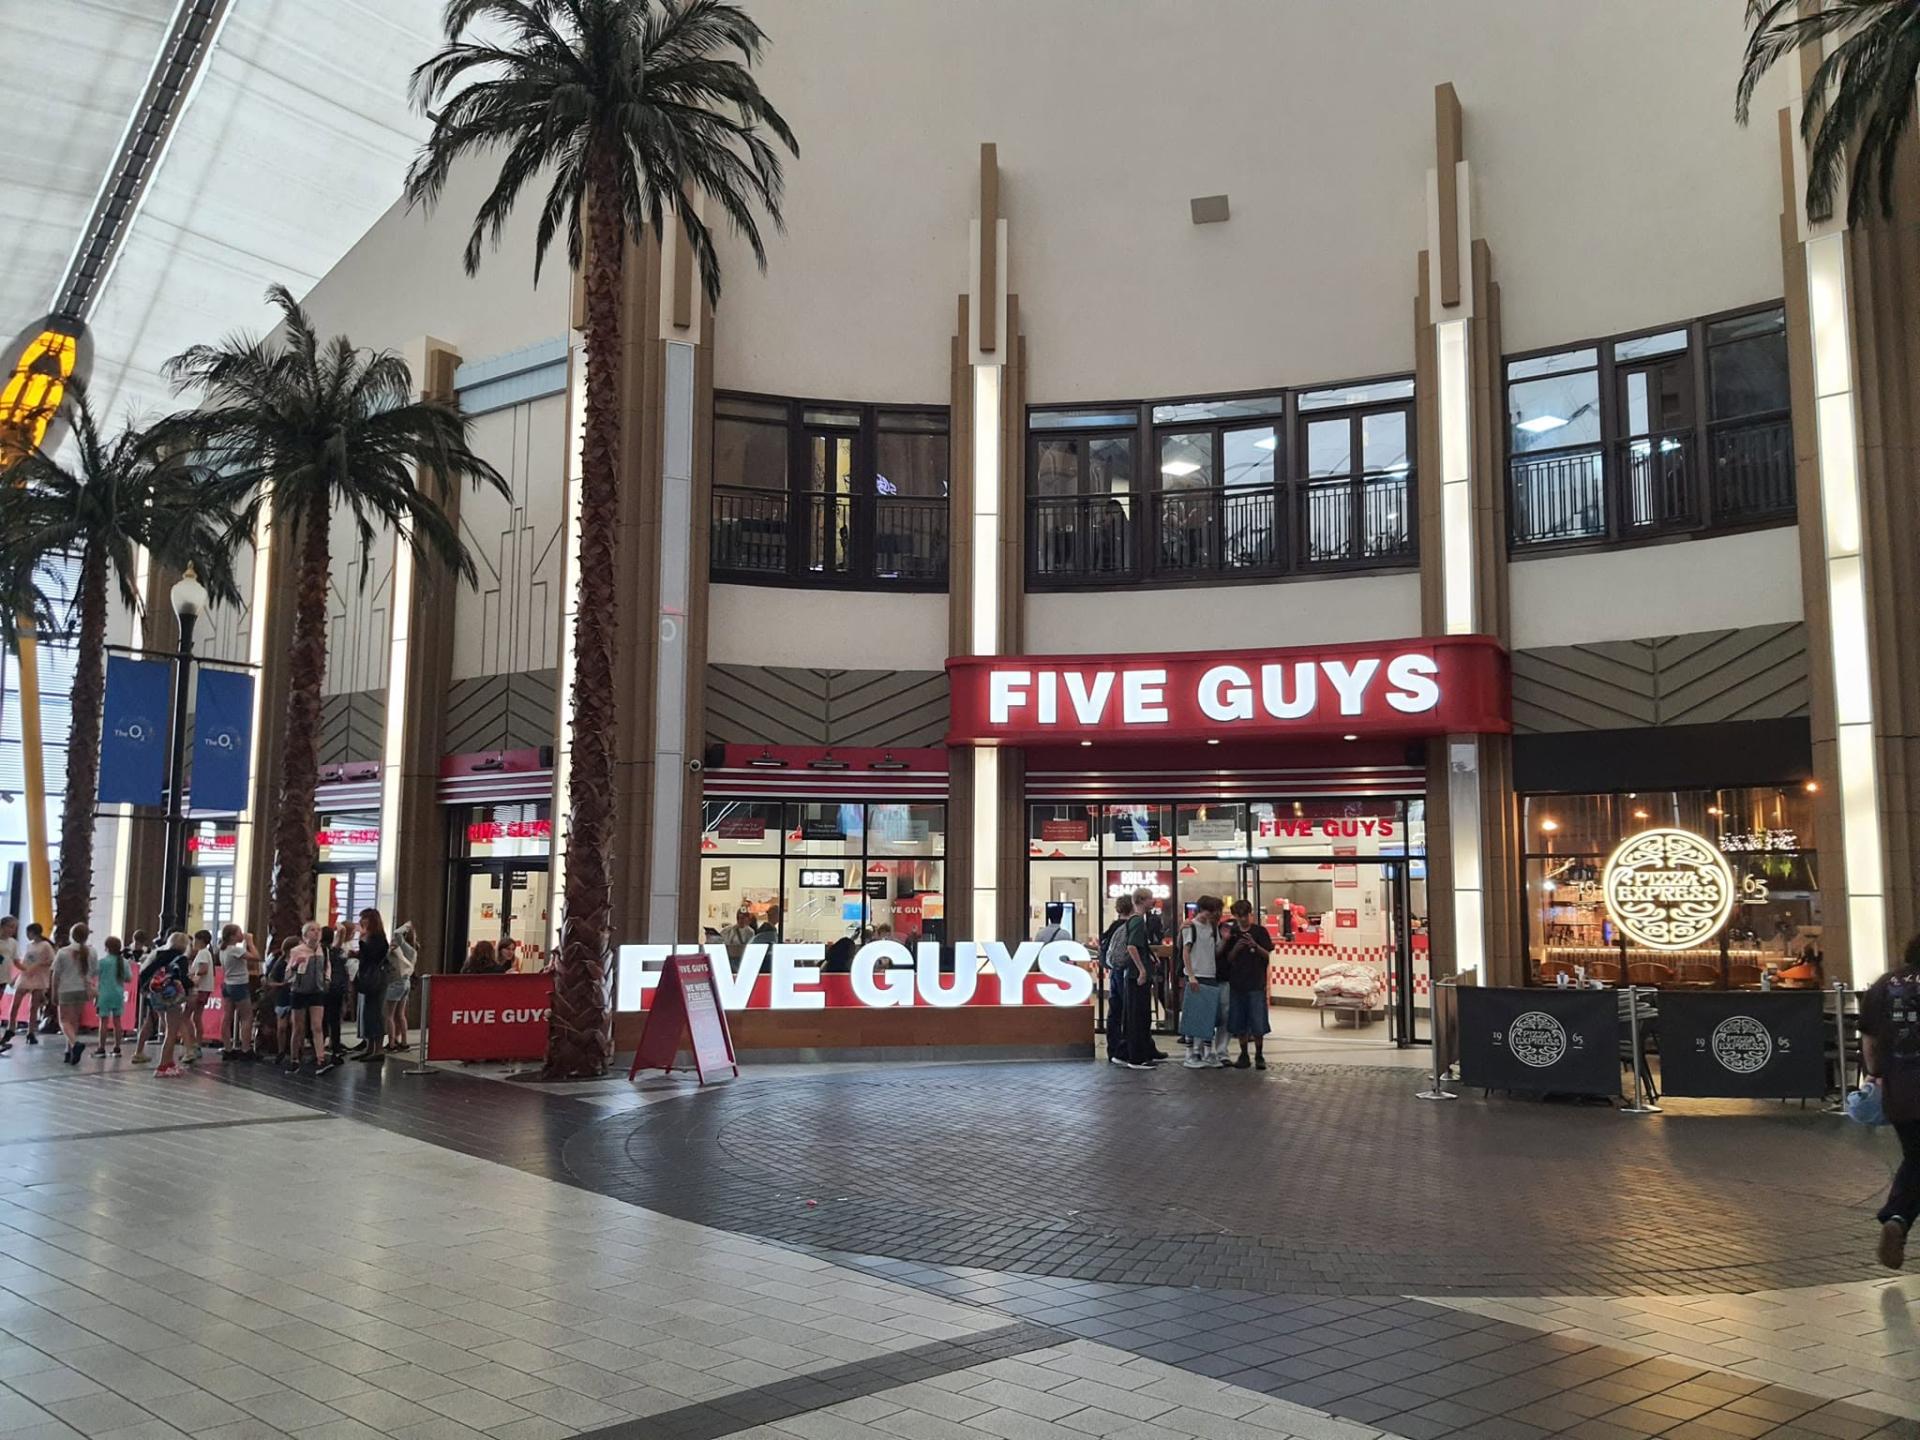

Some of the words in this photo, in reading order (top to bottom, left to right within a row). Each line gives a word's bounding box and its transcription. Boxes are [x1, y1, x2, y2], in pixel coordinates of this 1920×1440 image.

[989, 669, 1168, 724] FIVE
[1197, 653, 1440, 722] GUYS
[114, 728, 128, 737] The
[204, 738, 217, 747] The
[1259, 819, 1314, 837] FIVE
[1322, 817, 1393, 837] GUYS
[802, 871, 840, 886] BEER
[1120, 870, 1158, 884] MILK
[1634, 871, 1700, 886] PIZZA
[1108, 884, 1170, 899] SHAES
[1744, 873, 1769, 897] 65
[1617, 885, 1719, 902] EXPRESS
[904, 905, 922, 914] GUY
[617, 943, 825, 1012] FVE
[851, 940, 1093, 1007] GUYS
[451, 1009, 496, 1024] FIVE
[1492, 1031, 1503, 1041] 19
[1523, 1030, 1551, 1039] PIZZA
[1572, 1032, 1584, 1044] 65
[1726, 1035, 1756, 1043] PIZZA
[1515, 1037, 1560, 1046] EXPRESS
[1695, 1037, 1705, 1047] 19
[1777, 1036, 1790, 1048] 65
